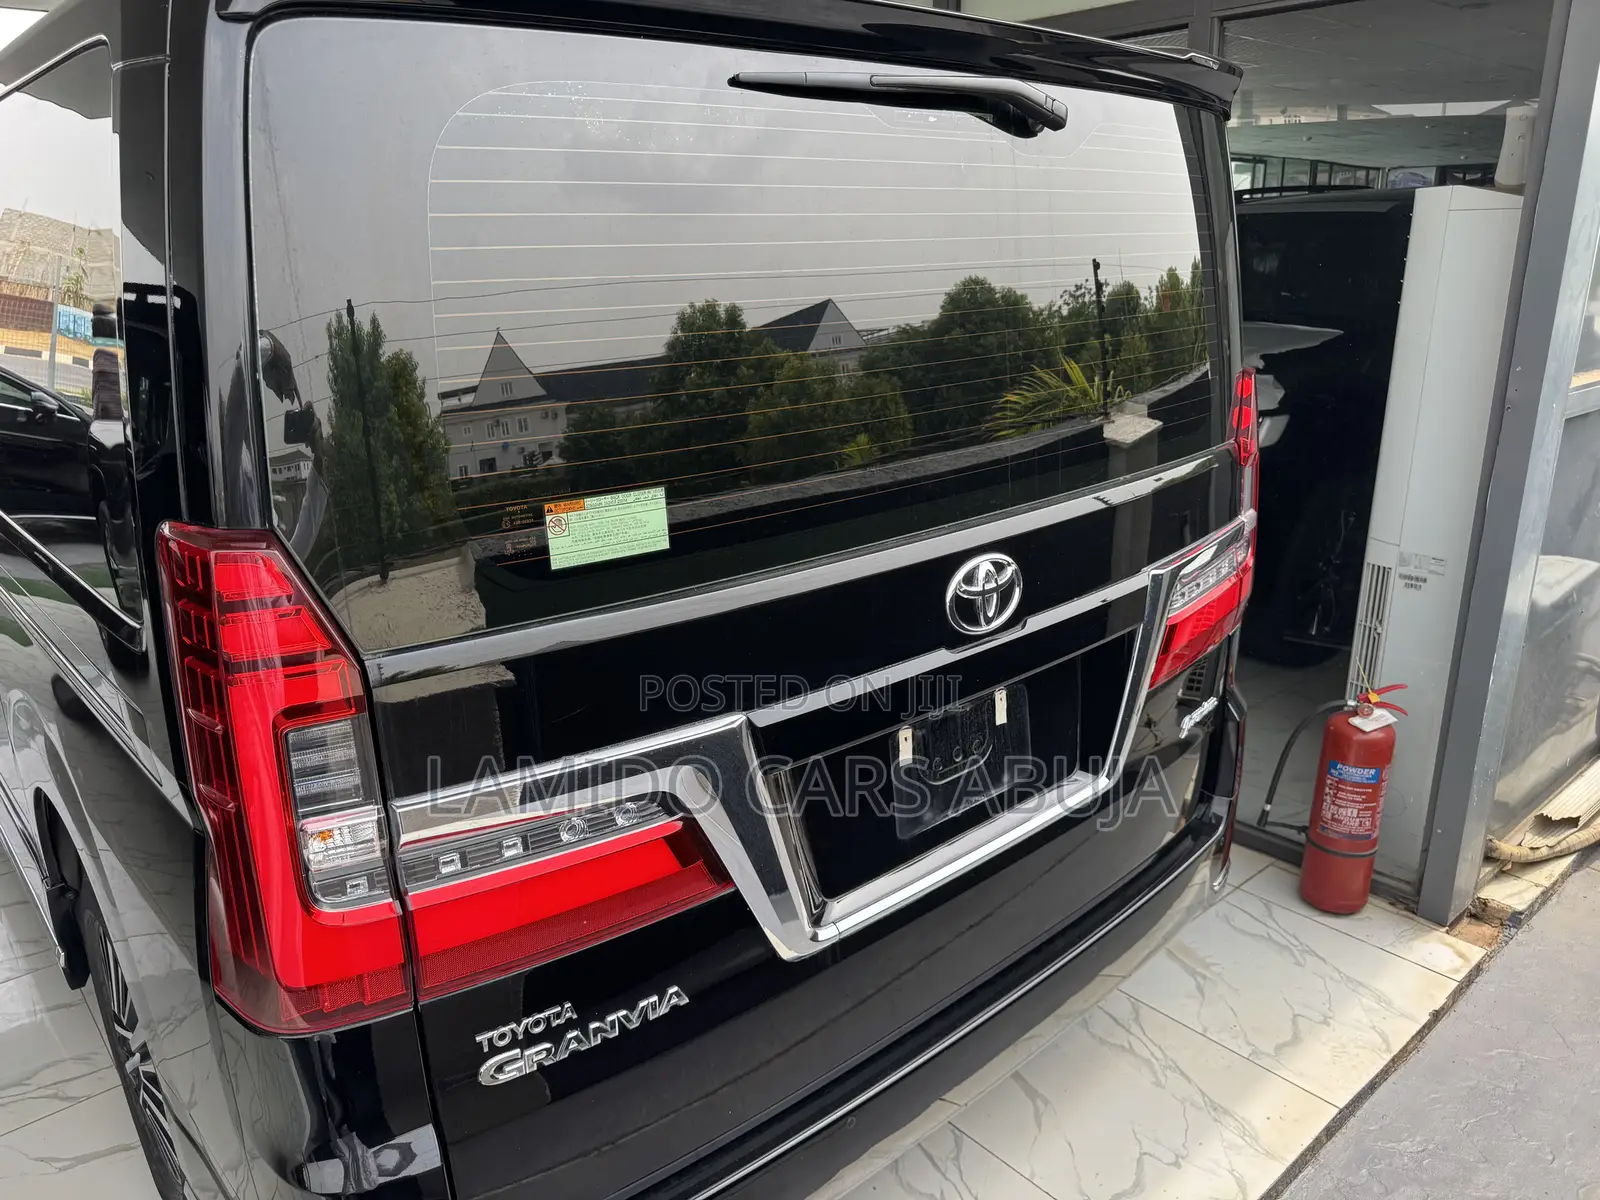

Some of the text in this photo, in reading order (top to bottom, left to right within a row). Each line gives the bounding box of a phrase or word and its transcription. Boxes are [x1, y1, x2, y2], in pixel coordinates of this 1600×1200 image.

[505, 504, 528, 512] TOYOTA
[1336, 763, 1377, 775] POWDER
[475, 1001, 578, 1053] TOYOTA
[477, 985, 690, 1086] GRANVIA
